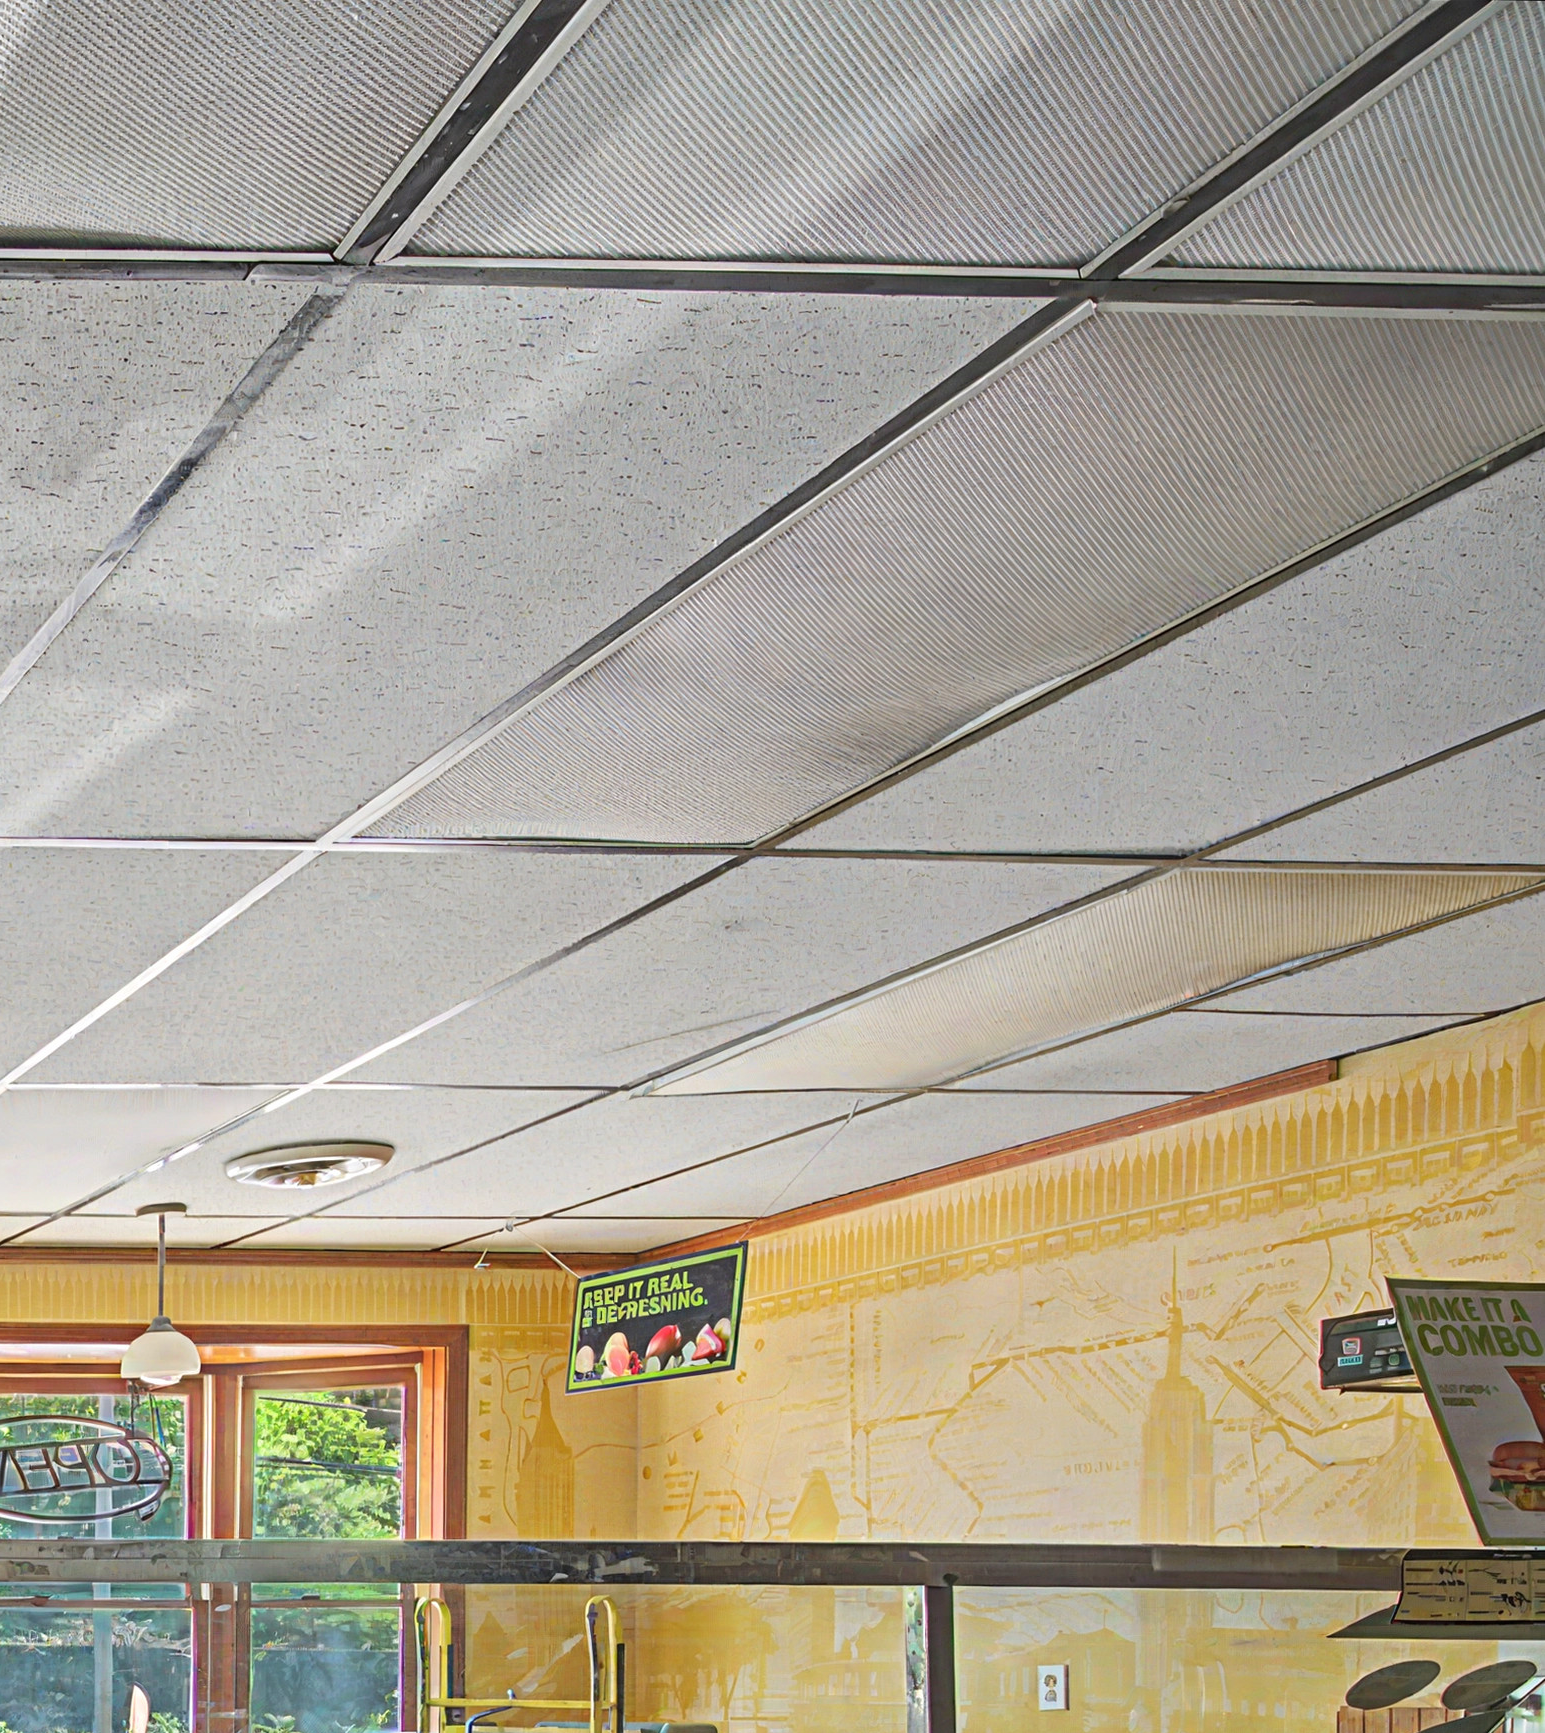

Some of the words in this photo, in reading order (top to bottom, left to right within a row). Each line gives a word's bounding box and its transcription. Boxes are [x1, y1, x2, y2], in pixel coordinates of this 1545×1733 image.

[628, 1280, 644, 1300] IT
[646, 1271, 694, 1297] REAL
[1405, 1295, 1482, 1322] MAKE
[1481, 1296, 1506, 1323] IT
[1510, 1298, 1533, 1323] A
[1416, 1322, 1544, 1358] COMBO
